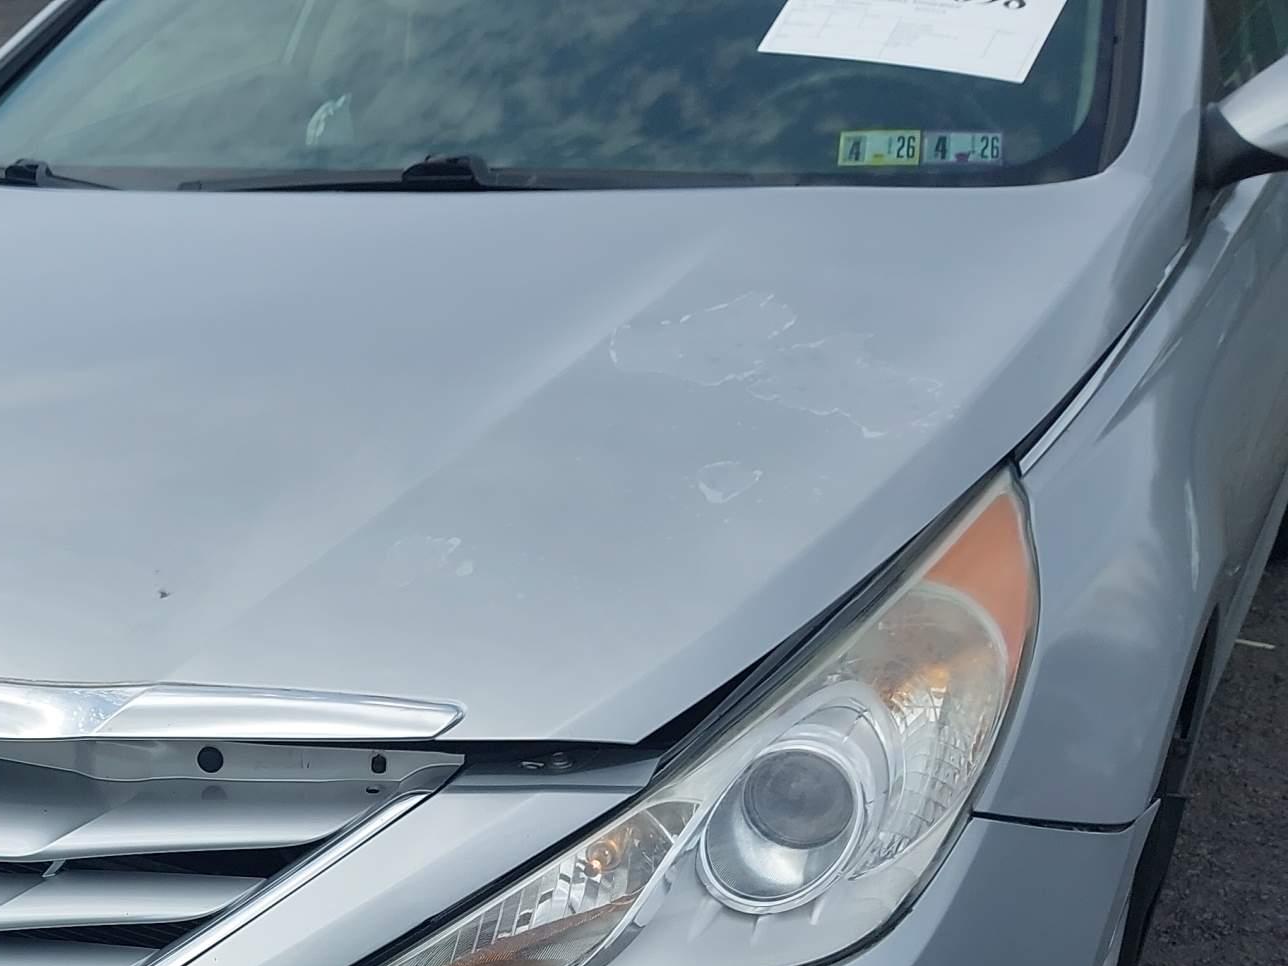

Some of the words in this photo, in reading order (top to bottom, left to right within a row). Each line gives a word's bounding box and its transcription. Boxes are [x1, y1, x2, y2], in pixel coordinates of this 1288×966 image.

[848, 140, 862, 161] 4
[896, 135, 916, 159] 26
[934, 135, 948, 161] 4
[980, 135, 1000, 160] 26
